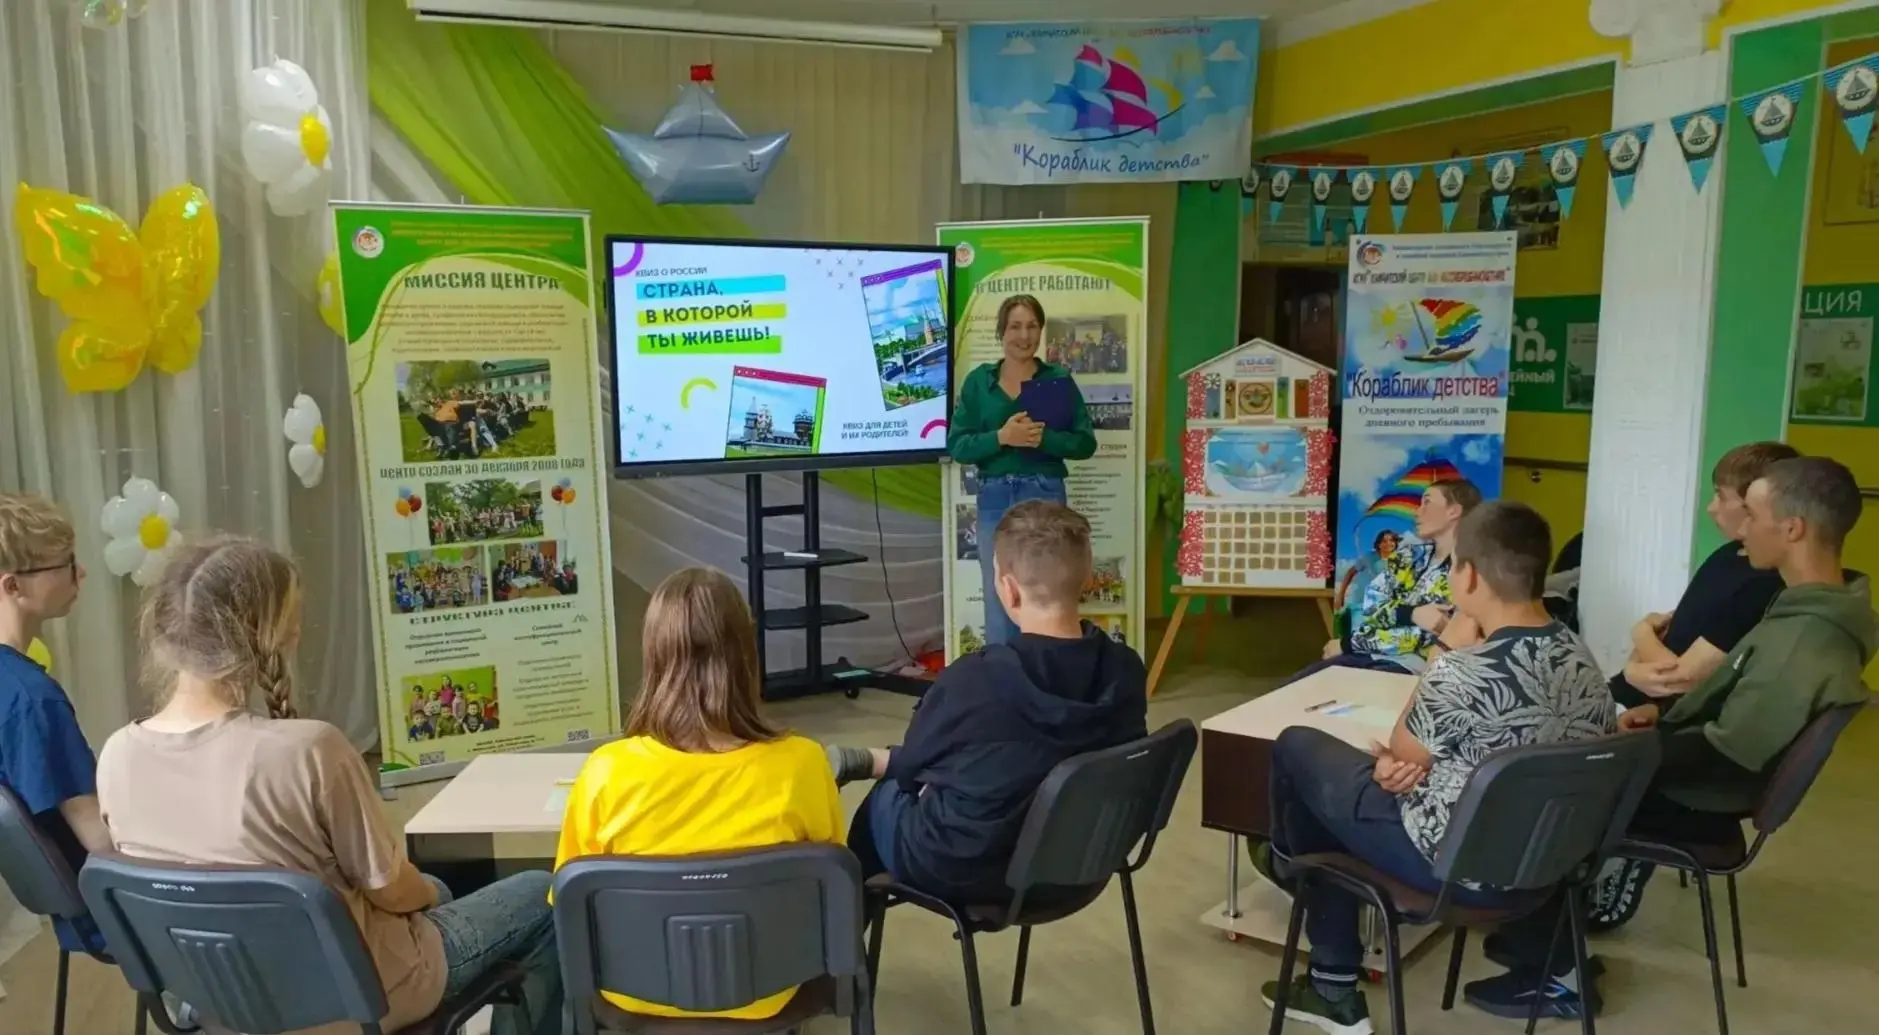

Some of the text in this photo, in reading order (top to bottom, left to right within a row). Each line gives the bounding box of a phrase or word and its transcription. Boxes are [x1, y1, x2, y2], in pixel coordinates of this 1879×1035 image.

[1014, 143, 1111, 176] "Кораблик
[404, 271, 560, 291] МИССИЯ ЦЕНТРА
[636, 267, 708, 277] КВИЗ О РОССИИ
[988, 275, 1037, 294] ЦЕНТРЕ
[1039, 274, 1111, 291] РАБОТАЮТ
[646, 300, 753, 323] В КОТОРОЙ
[648, 326, 770, 349] ТЫ ЖИВЕШЬ!
[1346, 370, 1429, 403] "Кораблик
[865, 421, 881, 430] ДЛЯ
[883, 419, 908, 429] ДЕТЕЙ
[418, 464, 462, 477] СОЗДАН
[464, 463, 478, 475] 30
[481, 461, 530, 474] ДЕКАБРЯ
[561, 457, 585, 470] ГОДА
